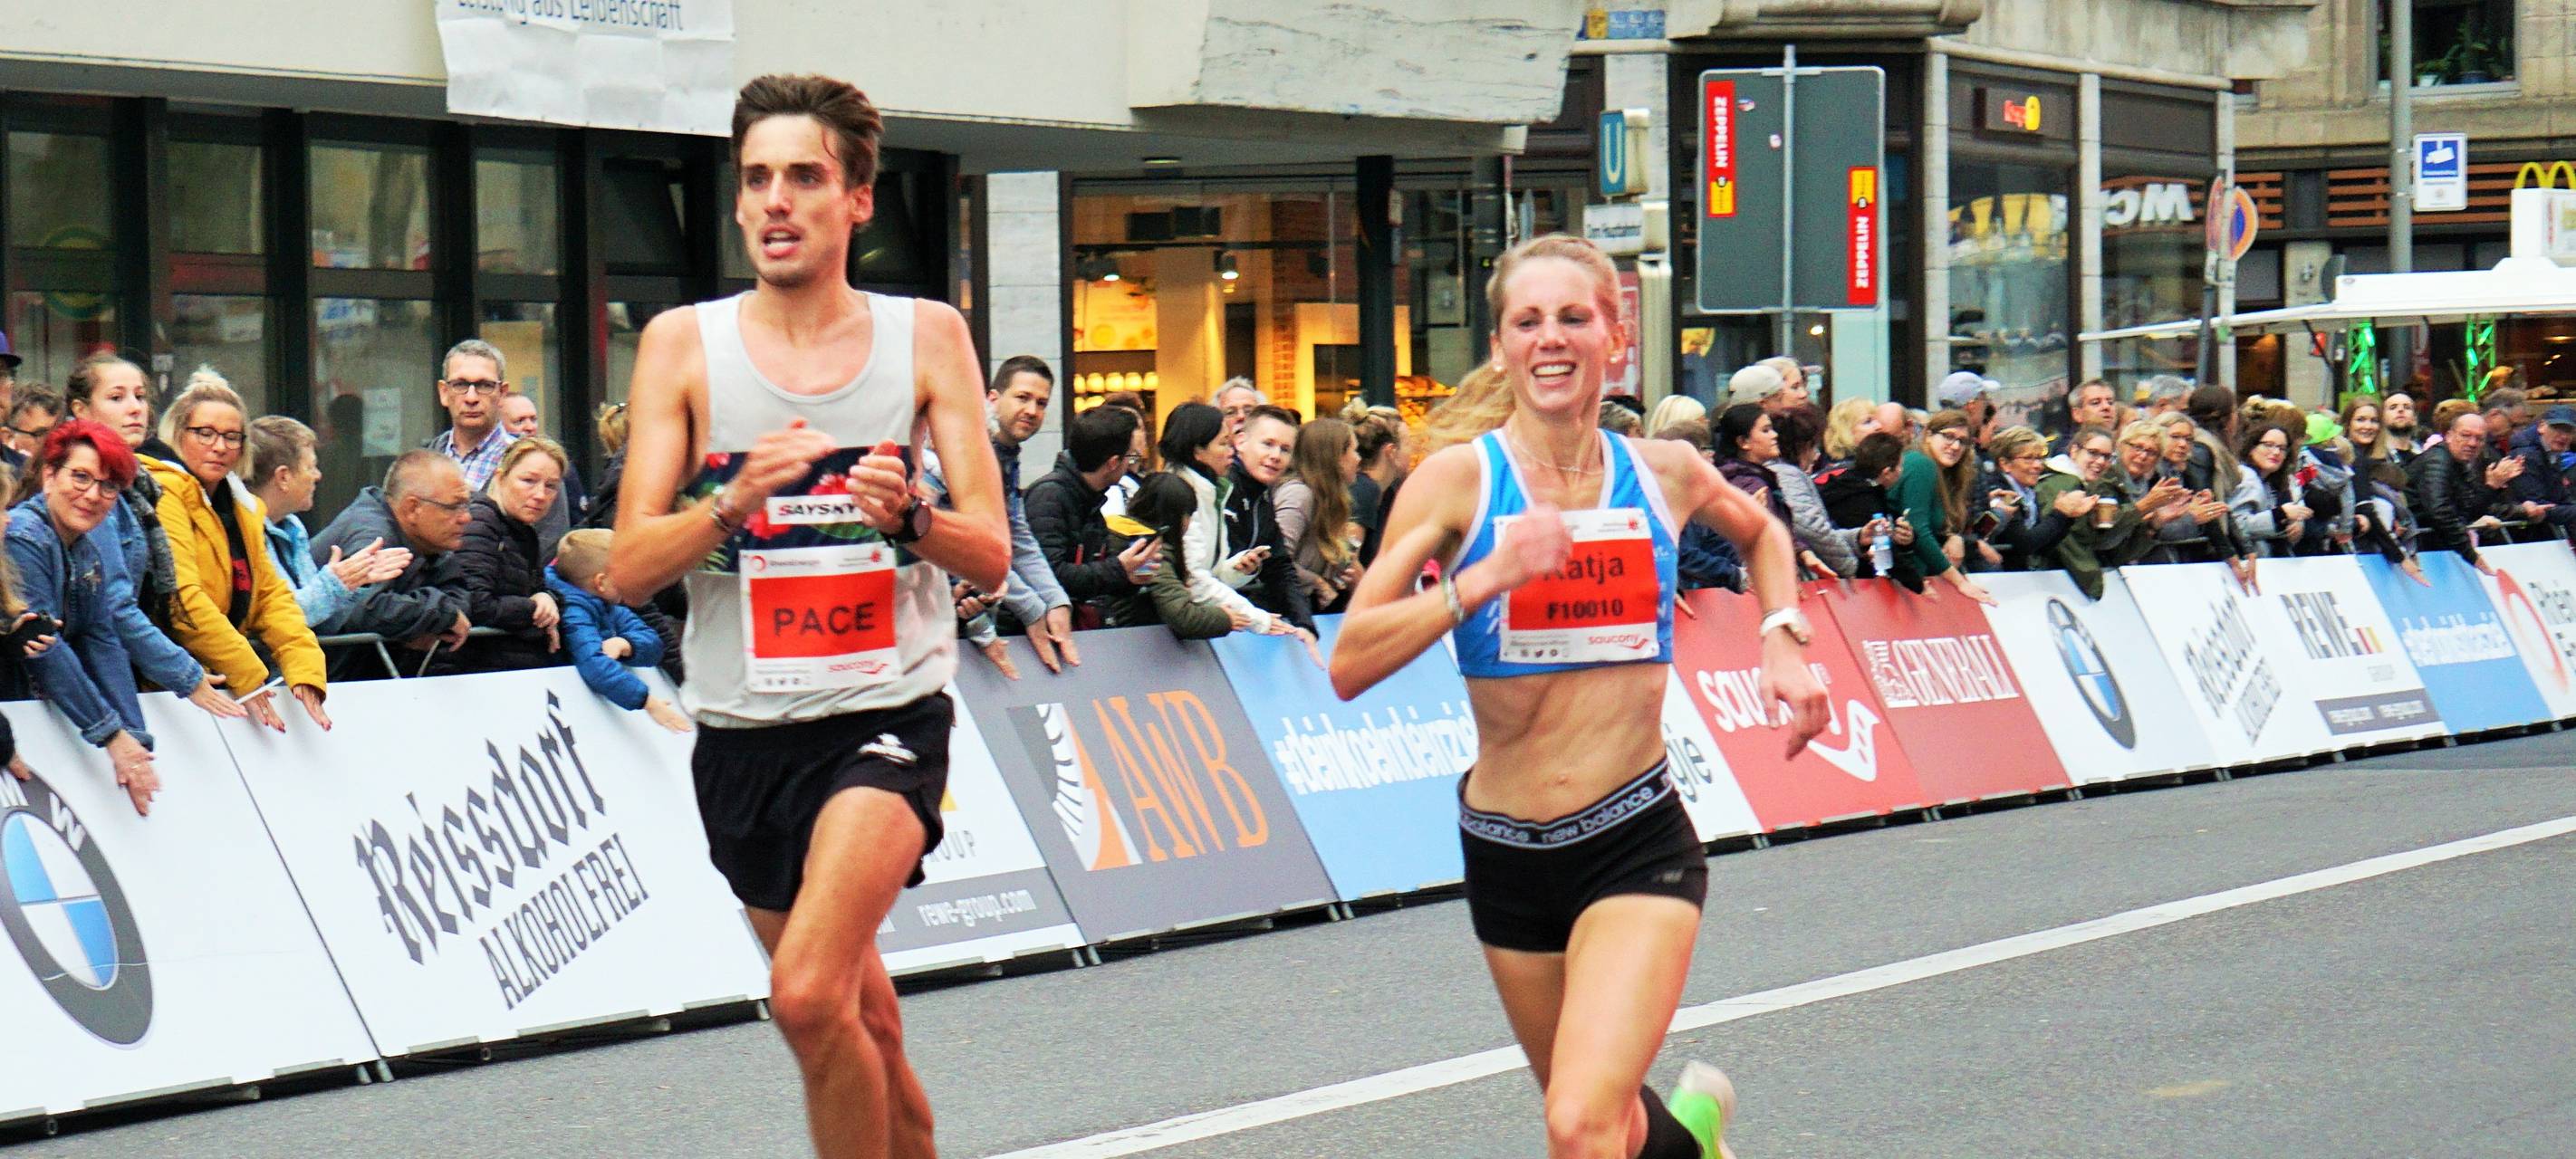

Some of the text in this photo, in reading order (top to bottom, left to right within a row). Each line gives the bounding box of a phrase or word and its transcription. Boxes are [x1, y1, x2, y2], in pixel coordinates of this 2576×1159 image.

[534, 0, 563, 17] aus
[571, 0, 684, 31] Leidenschaft
[1604, 122, 1623, 185] U
[1714, 96, 1729, 168] ZEPPELIN
[1855, 216, 1870, 290] ZEPPELIN
[1543, 552, 1625, 585] atja
[773, 601, 877, 637] PACE
[1546, 599, 1624, 621] F10010
[1588, 634, 1639, 646] saucony
[2280, 591, 2363, 660] REWE
[1697, 664, 1841, 735] sauy
[1891, 635, 2020, 706] GENERALI
[1092, 690, 1269, 862] AWB
[353, 688, 607, 966] Reissdorf
[929, 829, 977, 863] OUP
[1542, 822, 1580, 844] new
[1580, 785, 1655, 832] balance
[479, 832, 649, 1011] ALKOHOLFREI
[916, 889, 1038, 928] rewe-group.com
